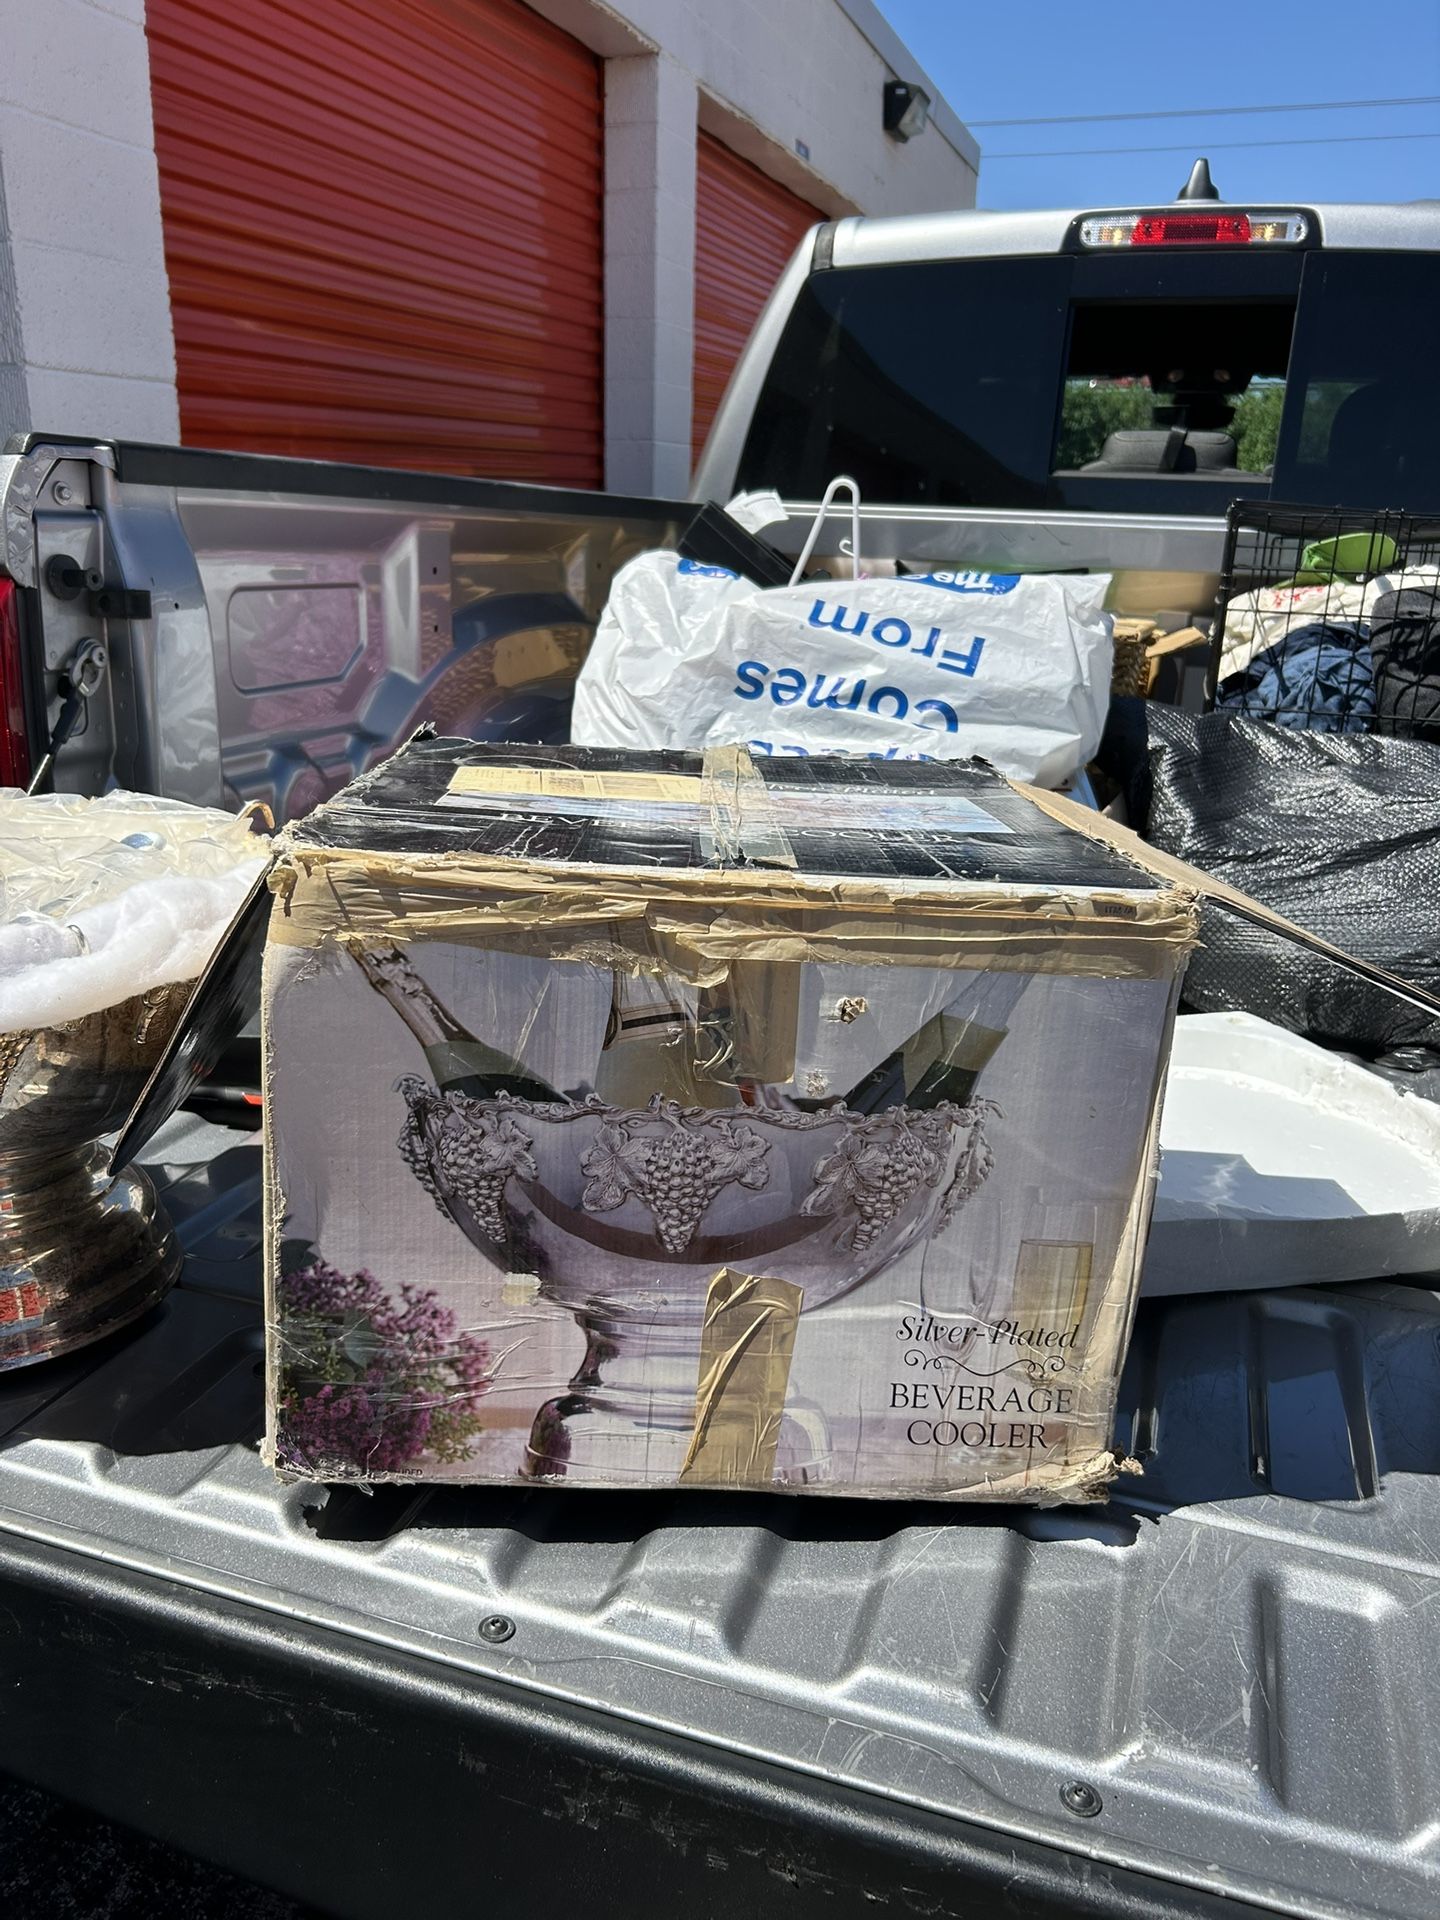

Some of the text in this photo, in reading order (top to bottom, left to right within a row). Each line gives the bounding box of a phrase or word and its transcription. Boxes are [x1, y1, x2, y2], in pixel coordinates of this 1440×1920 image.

[807, 598, 986, 678] From
[733, 660, 959, 733] Comes
[895, 1315, 1081, 1350] Silver-Plated
[889, 1382, 1074, 1414] BEVERAGE
[907, 1419, 1049, 1449] COOLER
